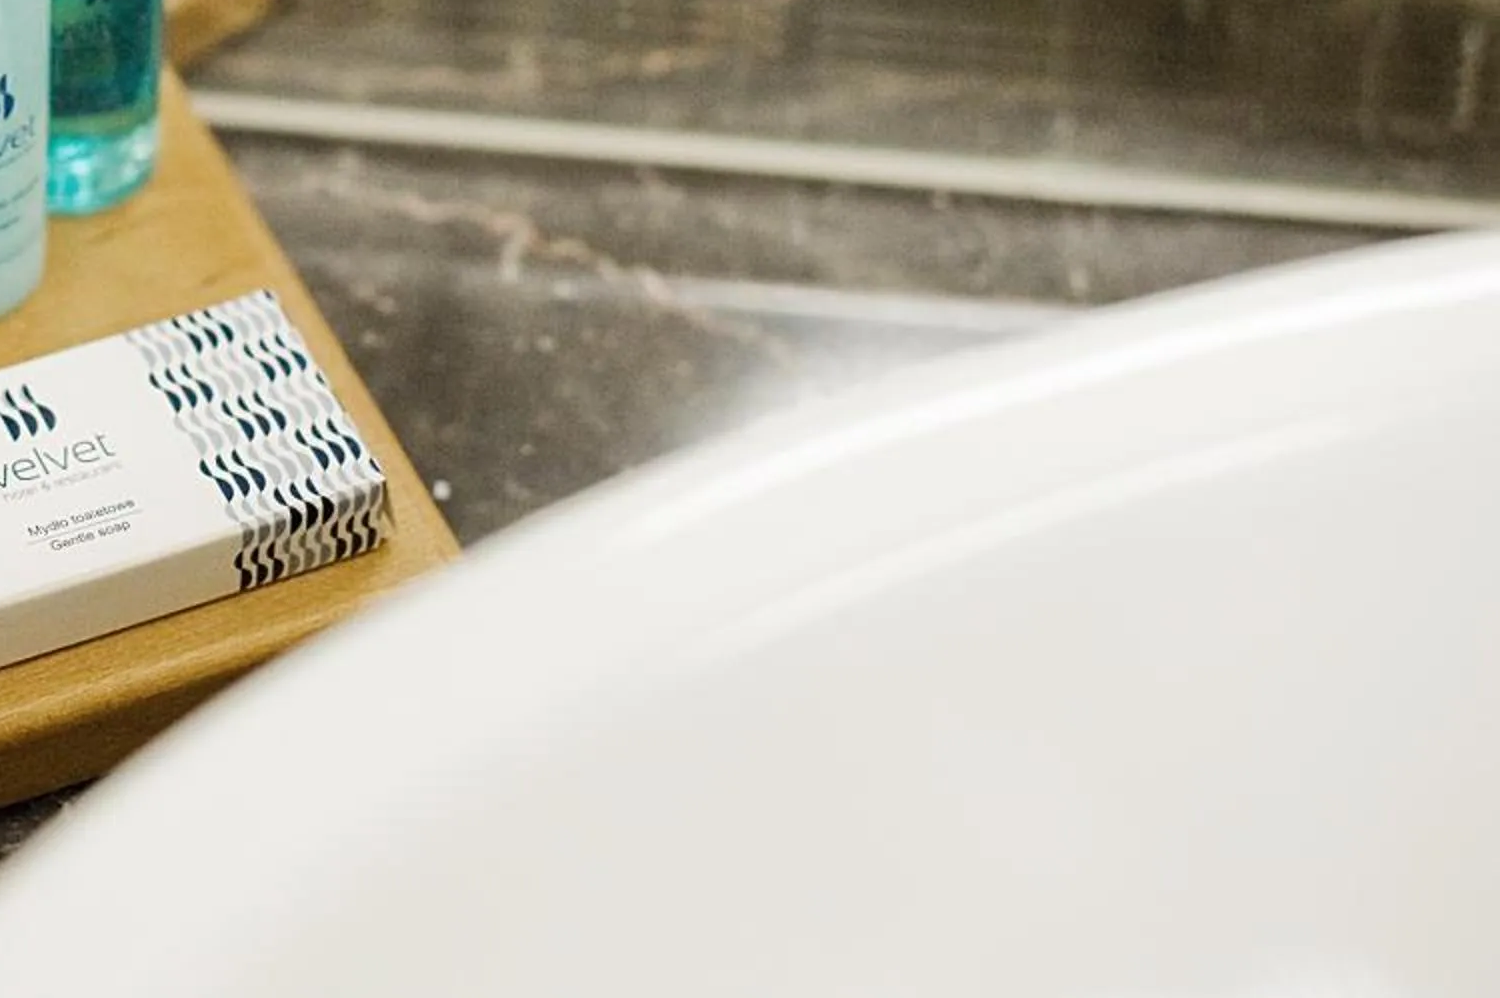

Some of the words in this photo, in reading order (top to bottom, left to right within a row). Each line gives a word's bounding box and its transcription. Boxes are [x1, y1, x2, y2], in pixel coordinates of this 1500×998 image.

[70, 499, 136, 525] toaletowe
[50, 530, 96, 552] Gentle
[98, 520, 132, 538] soap
